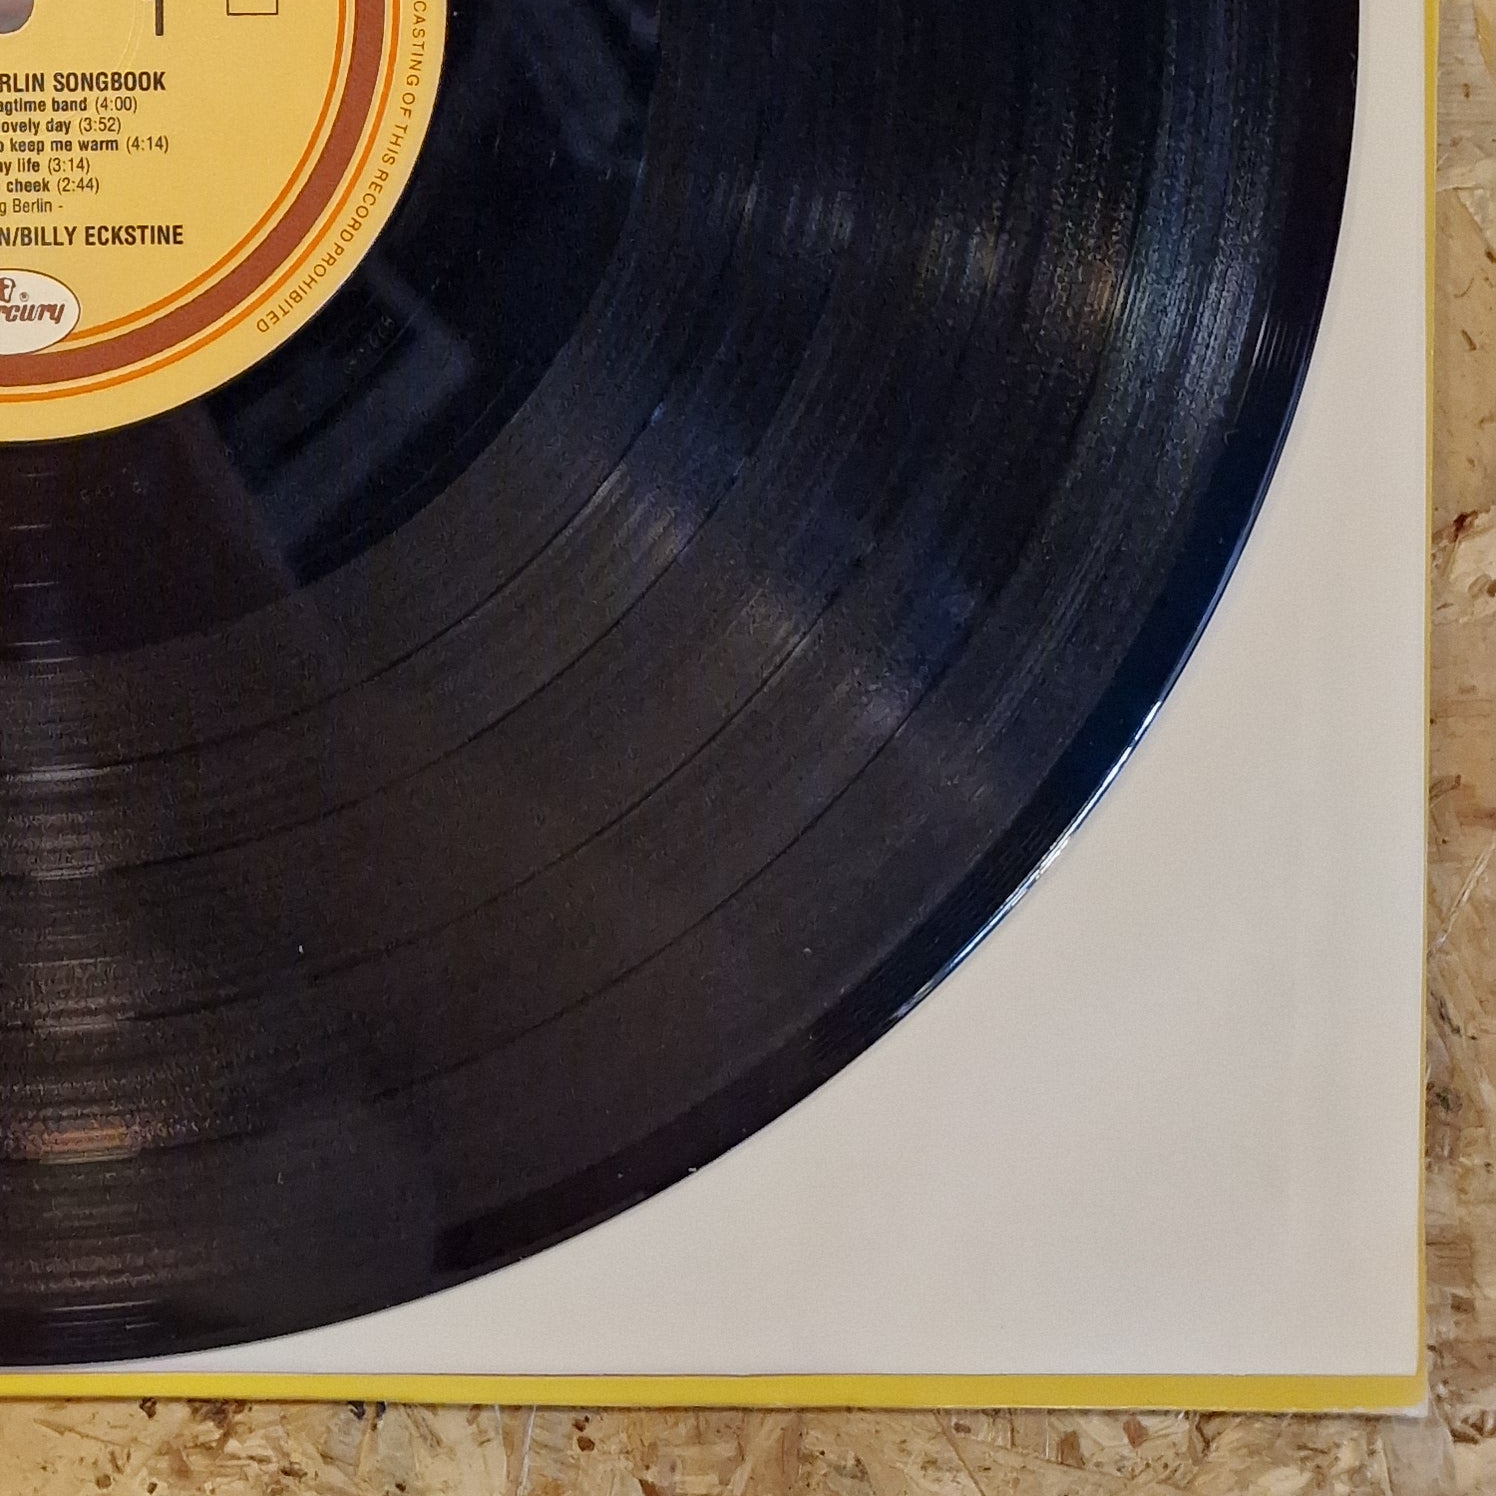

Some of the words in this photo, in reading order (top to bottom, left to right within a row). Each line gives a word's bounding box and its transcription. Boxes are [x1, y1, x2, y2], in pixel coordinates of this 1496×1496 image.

[52, 70, 167, 93] SONGBOOK
[51, 96, 88, 113] band
[94, 95, 138, 116] (4:00)
[398, 91, 416, 119] OF
[45, 117, 72, 136] day
[78, 116, 122, 136] (3:52)
[9, 136, 45, 156] keep
[50, 139, 73, 153] me
[77, 138, 120, 152] warm
[126, 134, 169, 155] (4:14)
[380, 123, 409, 165] THIS
[17, 156, 41, 174] life
[47, 156, 91, 176] (3:14)
[6, 176, 51, 194] cheek
[56, 176, 100, 196] (2:44)
[12, 197, 53, 214] Berlin
[338, 167, 389, 243] RECORD
[84, 224, 185, 247] ECKSTINE
[255, 241, 345, 333] PROHIBITED
